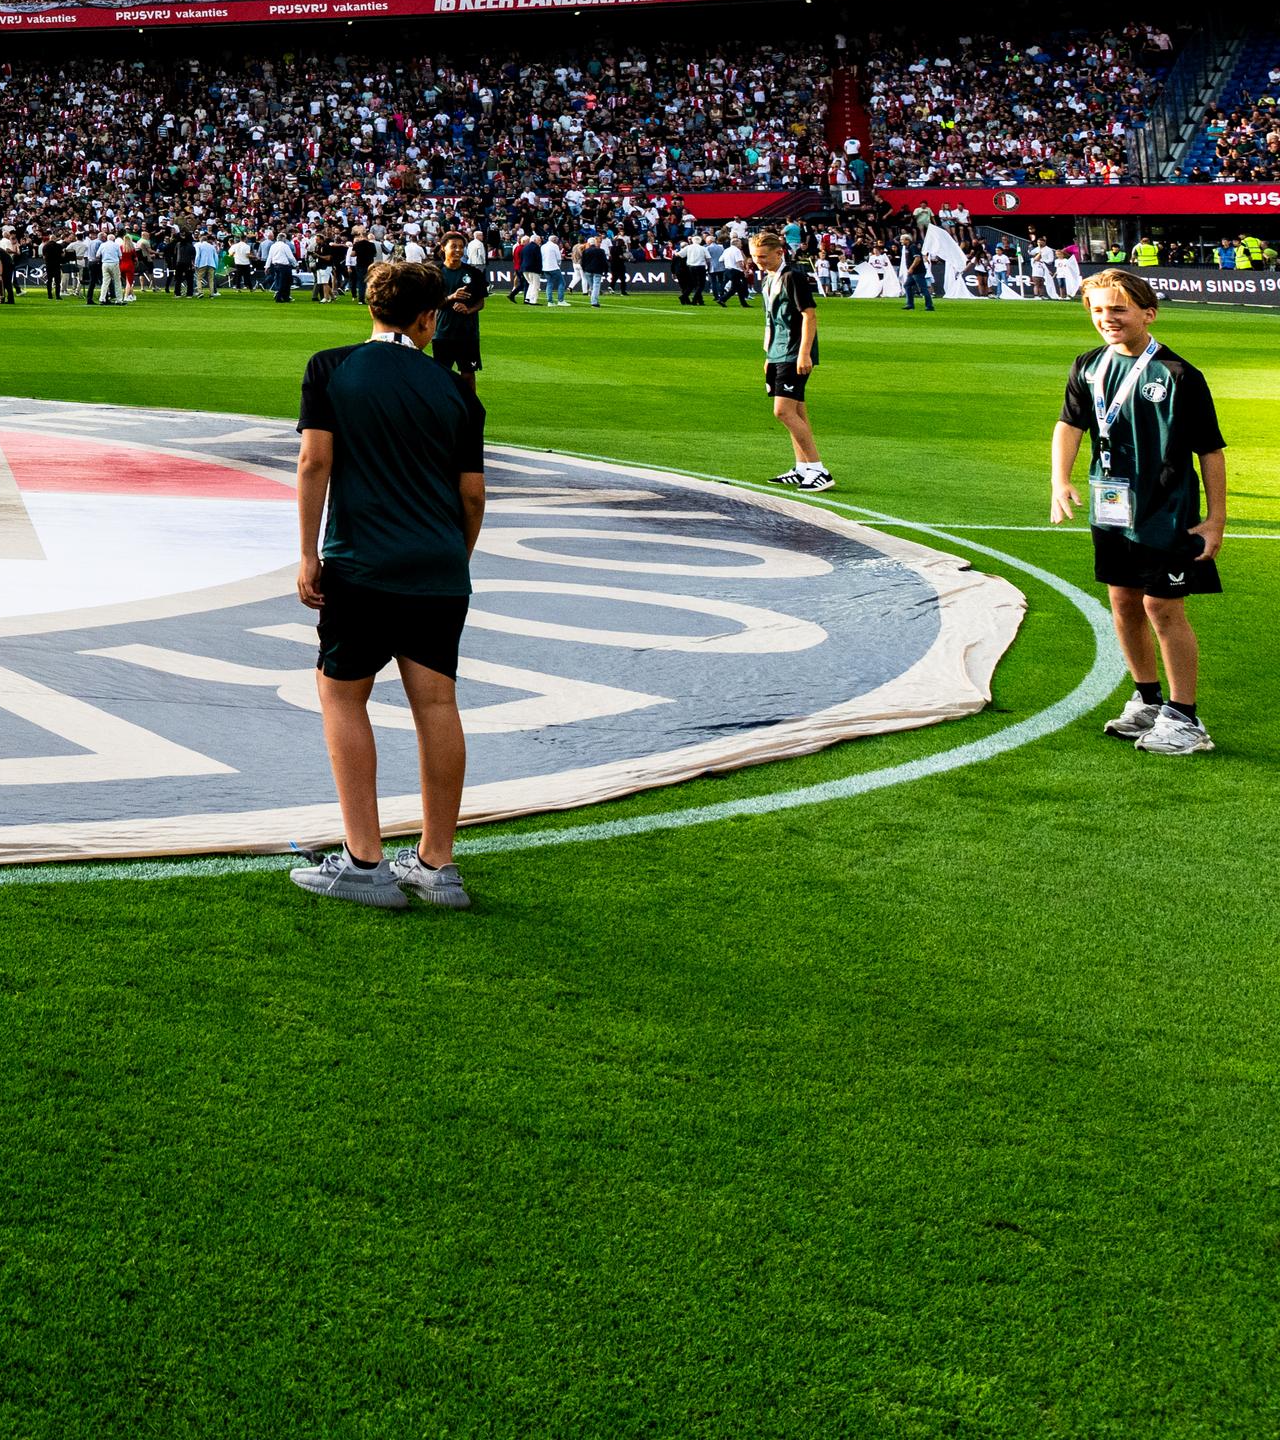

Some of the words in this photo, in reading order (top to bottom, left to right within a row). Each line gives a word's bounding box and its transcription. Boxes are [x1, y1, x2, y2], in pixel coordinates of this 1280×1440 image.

[332, 1, 389, 13] vakanties
[26, 13, 77, 24] vakanties
[175, 8, 228, 19] vakanties
[489, 270, 511, 282] IN
[1206, 279, 1257, 293] SINDS
